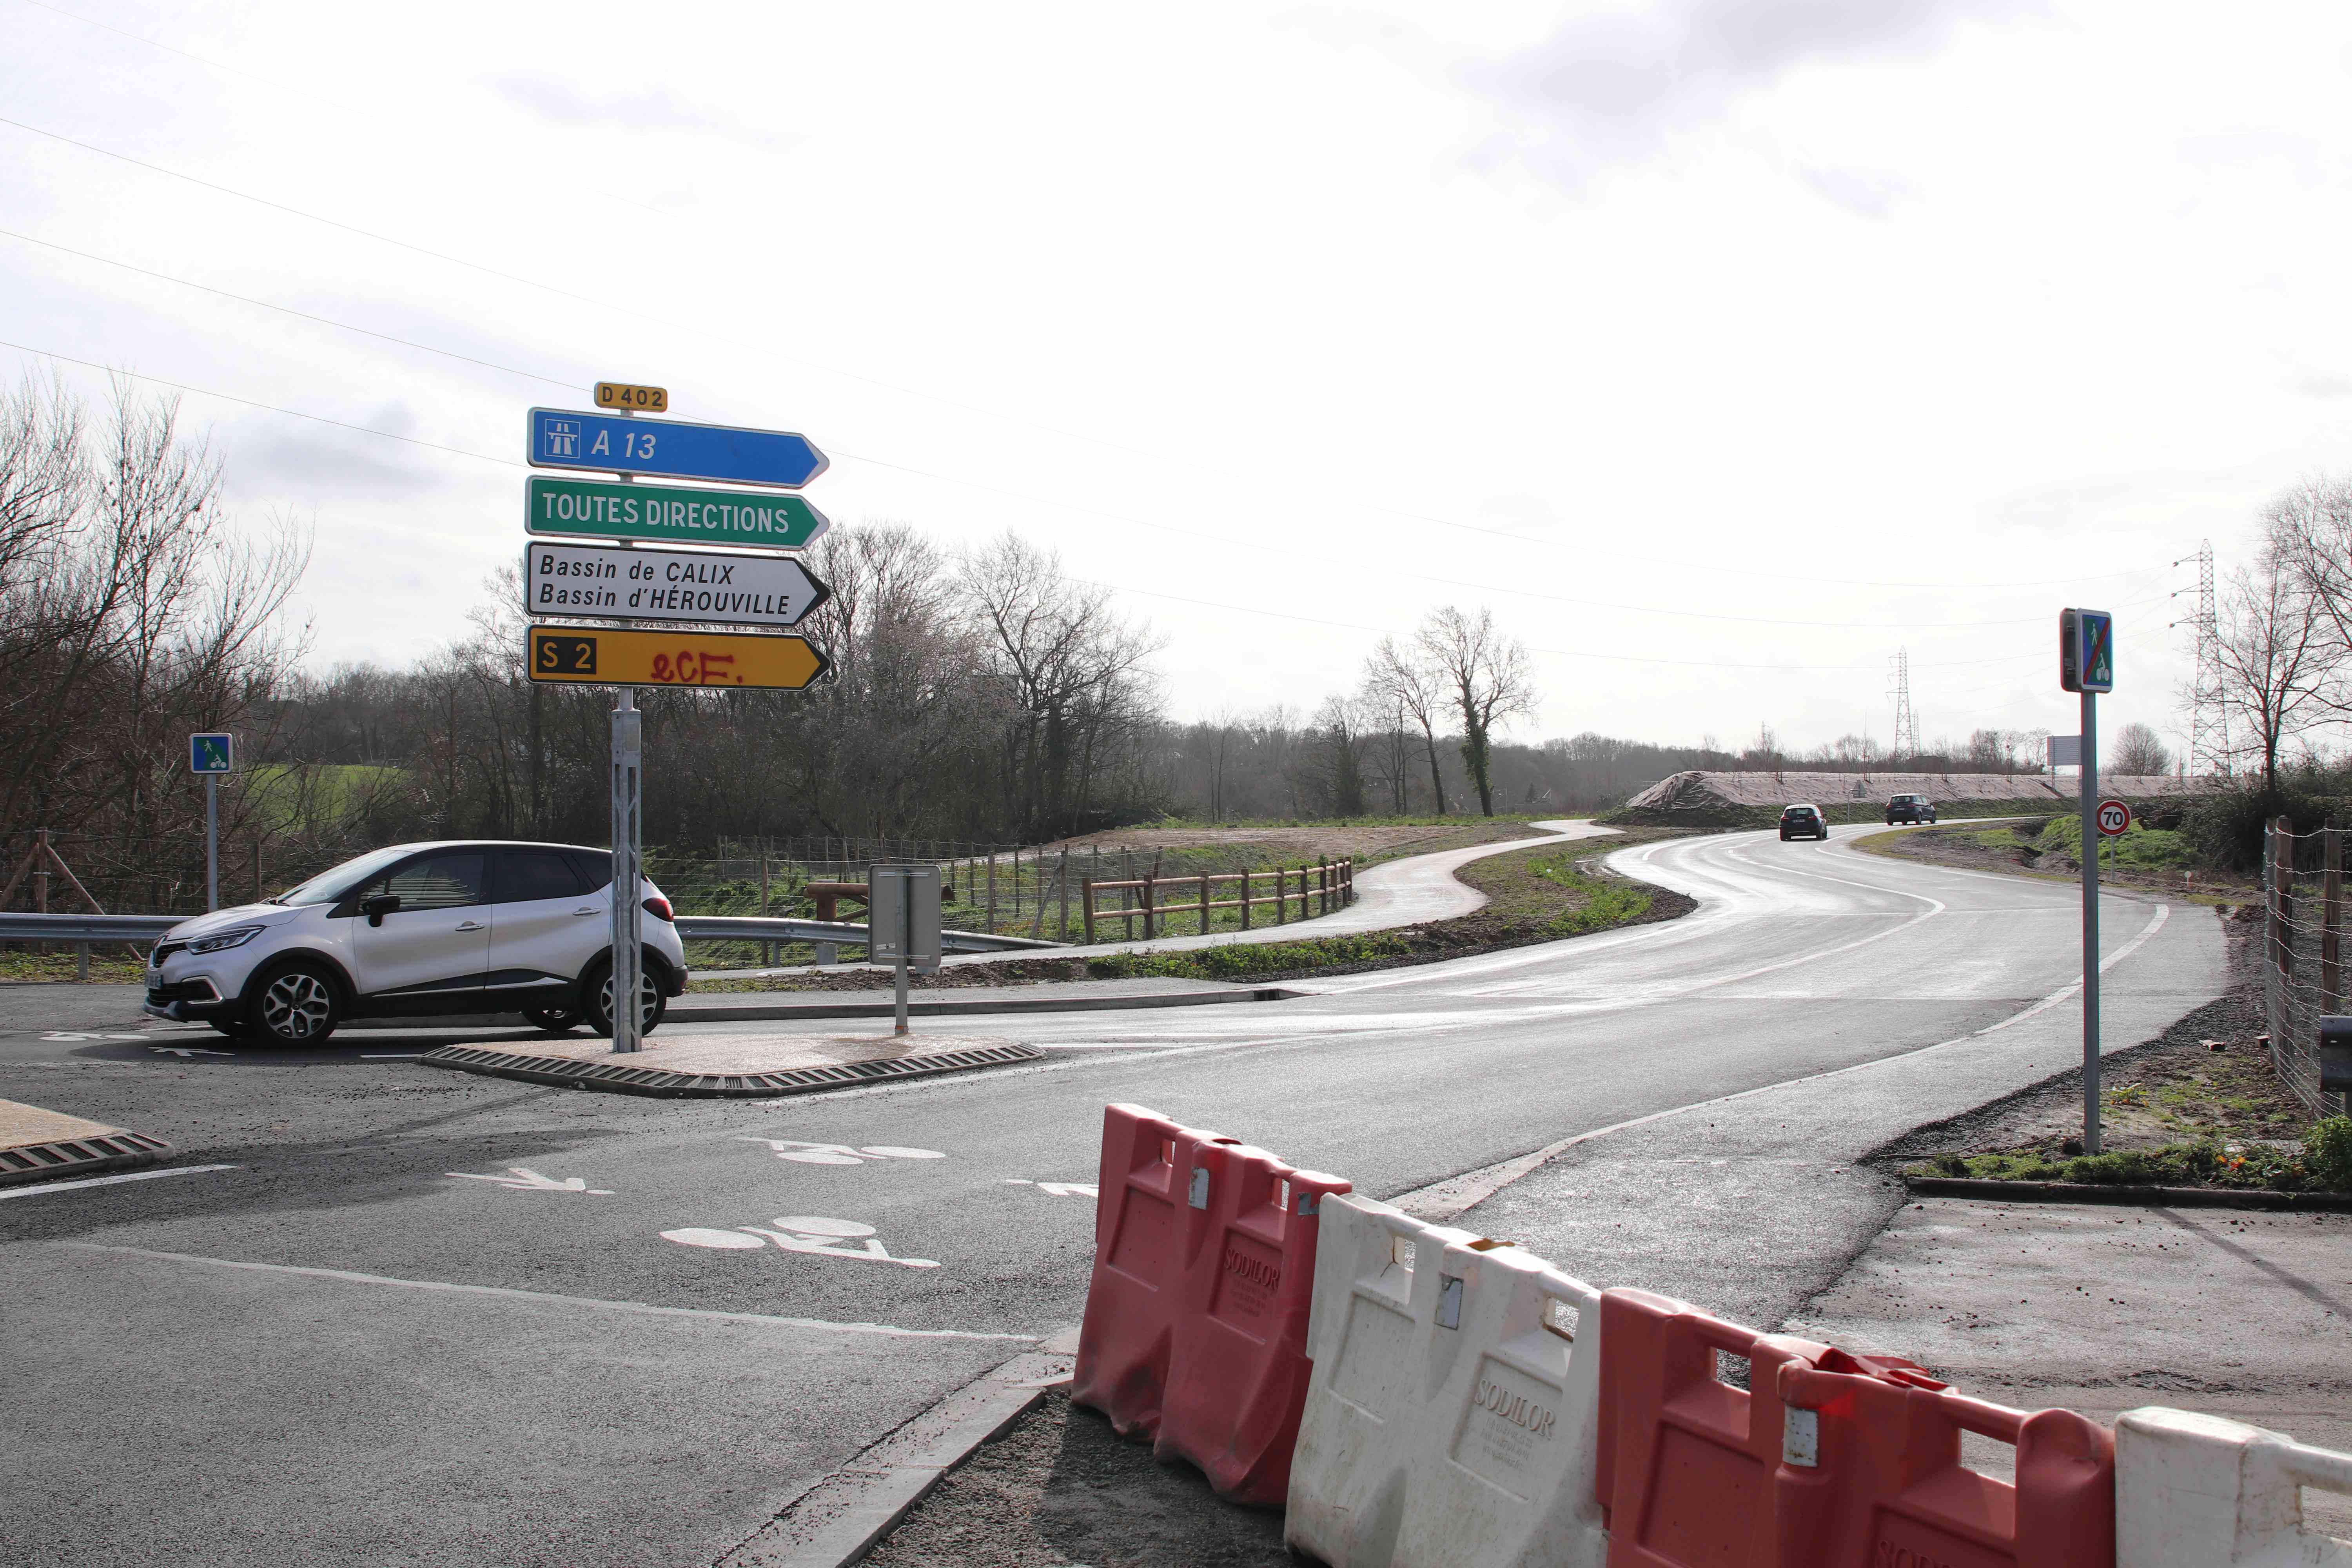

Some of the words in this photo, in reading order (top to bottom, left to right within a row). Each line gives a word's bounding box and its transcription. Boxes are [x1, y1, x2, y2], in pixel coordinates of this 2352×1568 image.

[603, 387, 613, 402] D
[621, 388, 662, 407] 402
[591, 430, 610, 456] A
[625, 433, 657, 459] 13
[543, 493, 639, 524] TOUTES
[646, 500, 789, 534] DIRECTIONS
[540, 555, 616, 579] Bassin
[629, 561, 654, 580] de
[666, 562, 735, 584] CALIX
[539, 583, 616, 606] Bassin
[629, 585, 789, 615] d'HÉROUVILLE
[542, 642, 558, 668] S
[575, 643, 591, 669] 2
[2103, 812, 2123, 826] 70
[1224, 1248, 1279, 1291] SODILOR
[1474, 1379, 1556, 1440] SODILOR
